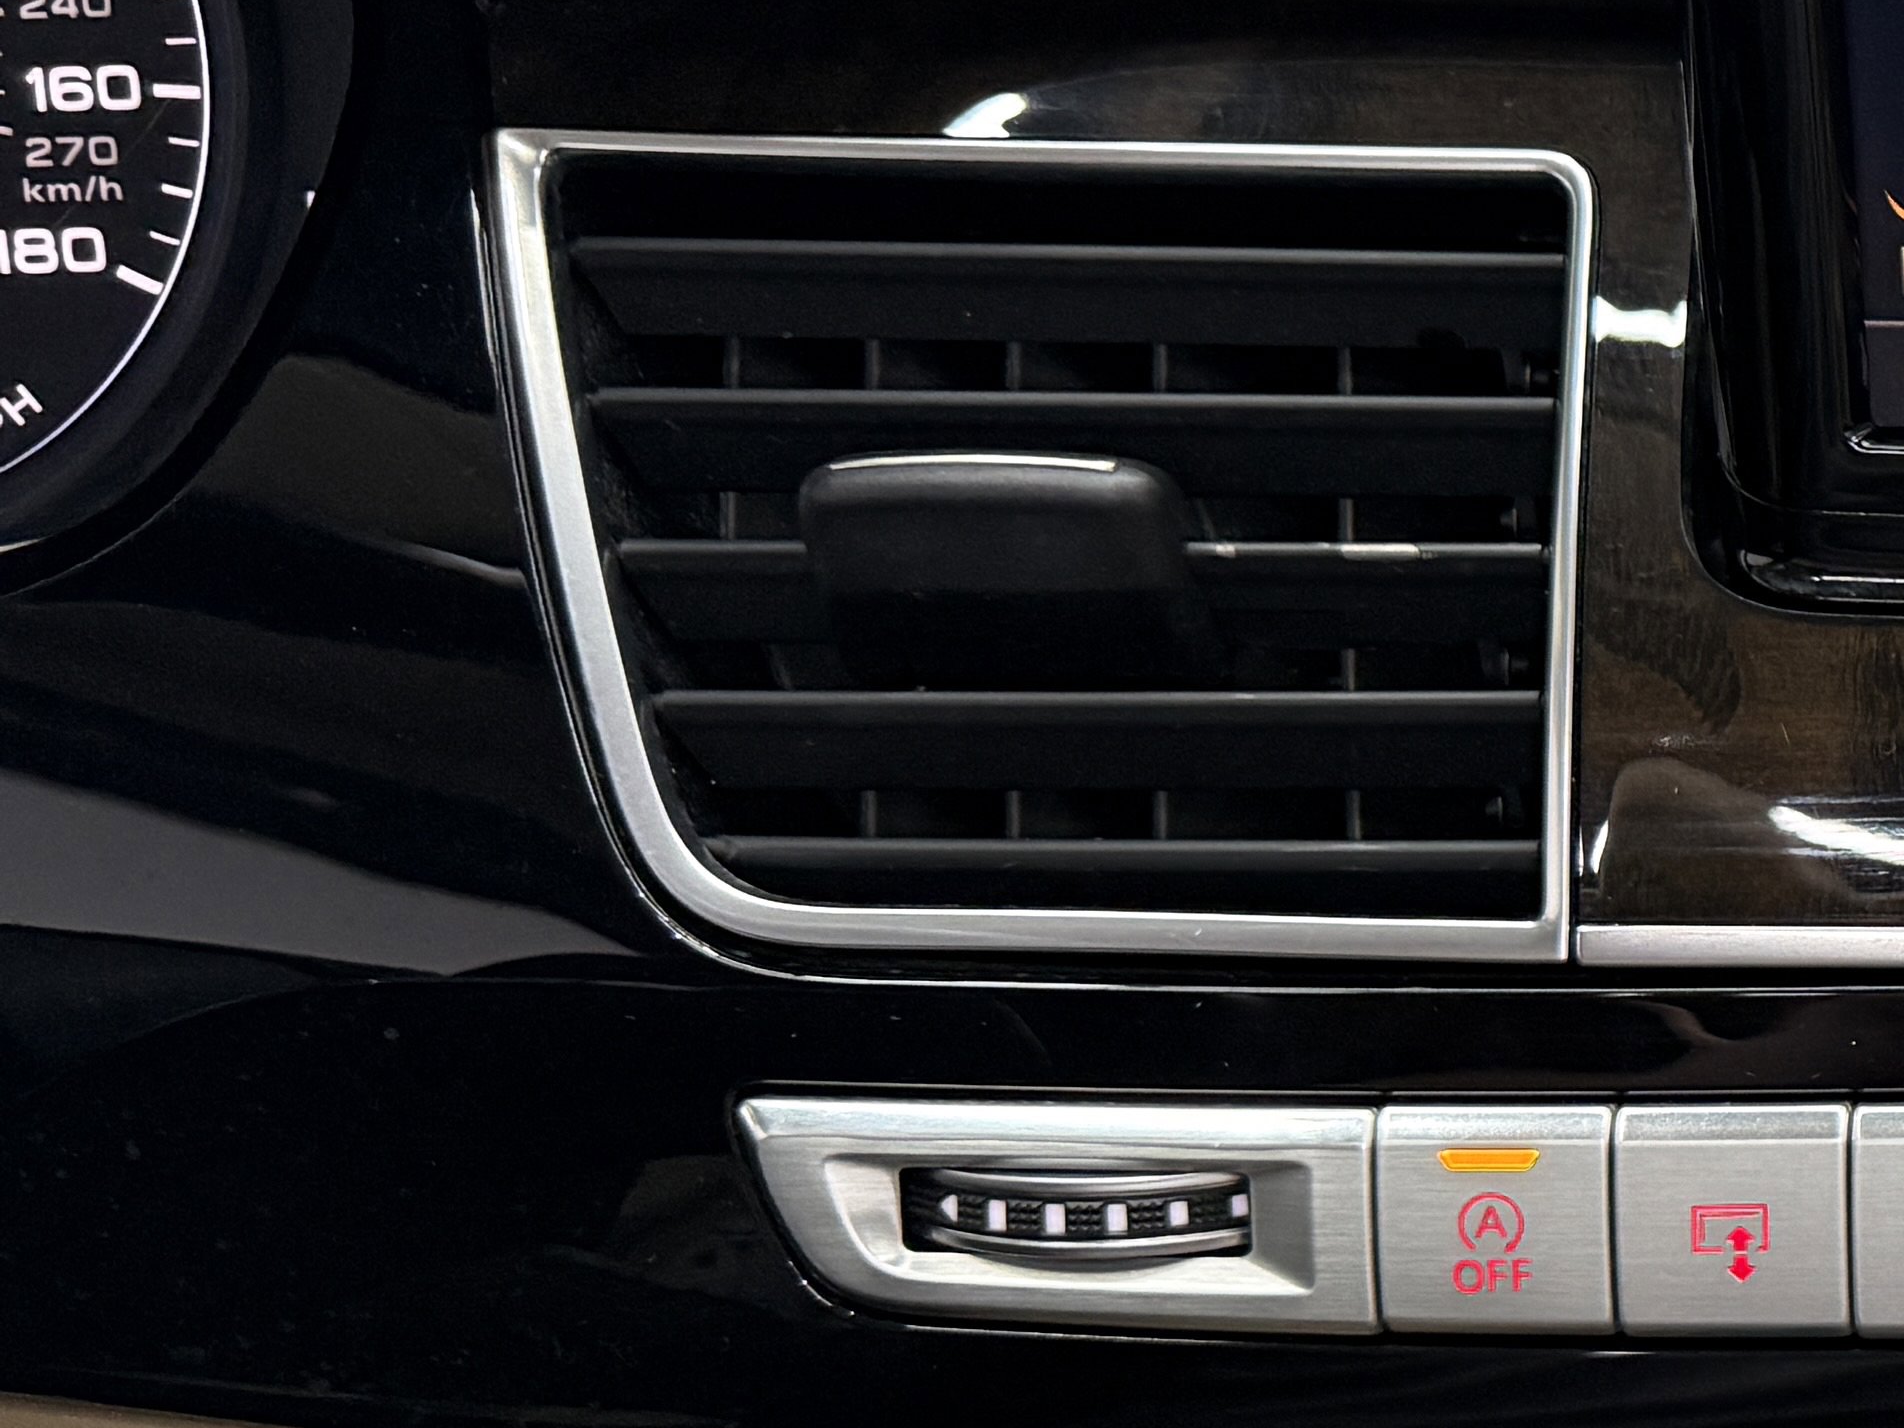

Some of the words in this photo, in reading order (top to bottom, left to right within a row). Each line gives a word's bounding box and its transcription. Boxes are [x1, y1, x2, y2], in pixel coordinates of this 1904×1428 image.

[25, 64, 142, 113] 160
[25, 135, 118, 168] 270
[22, 175, 123, 204] km/h
[1452, 1258, 1533, 1296] OFF
